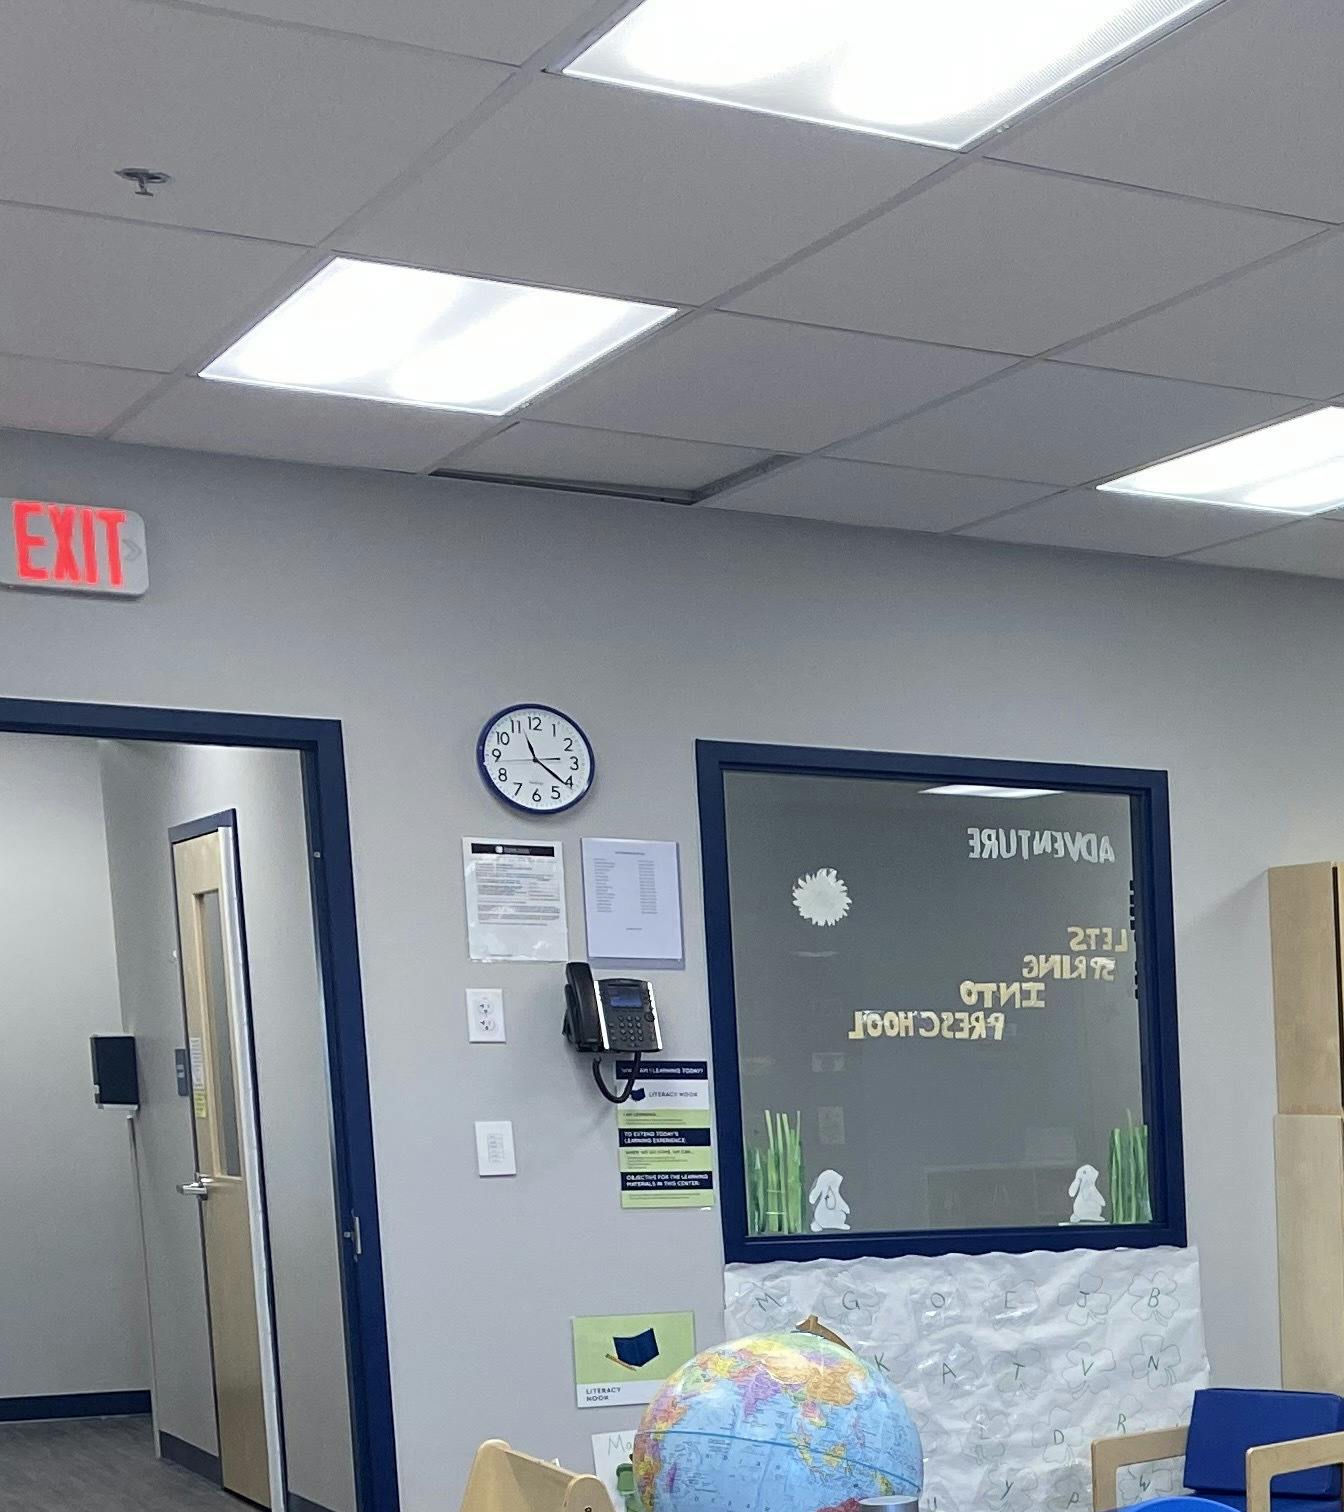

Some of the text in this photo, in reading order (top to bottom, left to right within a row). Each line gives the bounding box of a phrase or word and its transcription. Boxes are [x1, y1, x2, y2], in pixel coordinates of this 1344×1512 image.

[12, 501, 125, 587] EXIT
[511, 720, 521, 733] 11
[528, 716, 542, 731] 12
[496, 731, 510, 745] 10
[563, 738, 573, 751] 2
[492, 749, 501, 762] 9
[570, 756, 579, 770] 3
[498, 768, 507, 782] 8
[565, 775, 573, 789] 4
[513, 782, 522, 796] 7
[532, 788, 541, 802] 6
[551, 786, 560, 799] 5
[755, 1292, 782, 1312] M
[842, 1290, 860, 1310] G
[931, 1293, 945, 1308] O
[1079, 1291, 1090, 1308] J
[1148, 1288, 1160, 1307] B
[874, 1352, 891, 1372] K
[1082, 1359, 1094, 1376] V
[1148, 1356, 1159, 1371] N
[942, 1362, 956, 1384] A
[1014, 1362, 1025, 1380] T
[586, 1387, 621, 1395] LITERACY
[1117, 1413, 1126, 1434] R
[1054, 1429, 1064, 1445] D
[1139, 1474, 1151, 1492] W
[1066, 1492, 1079, 1509] P
